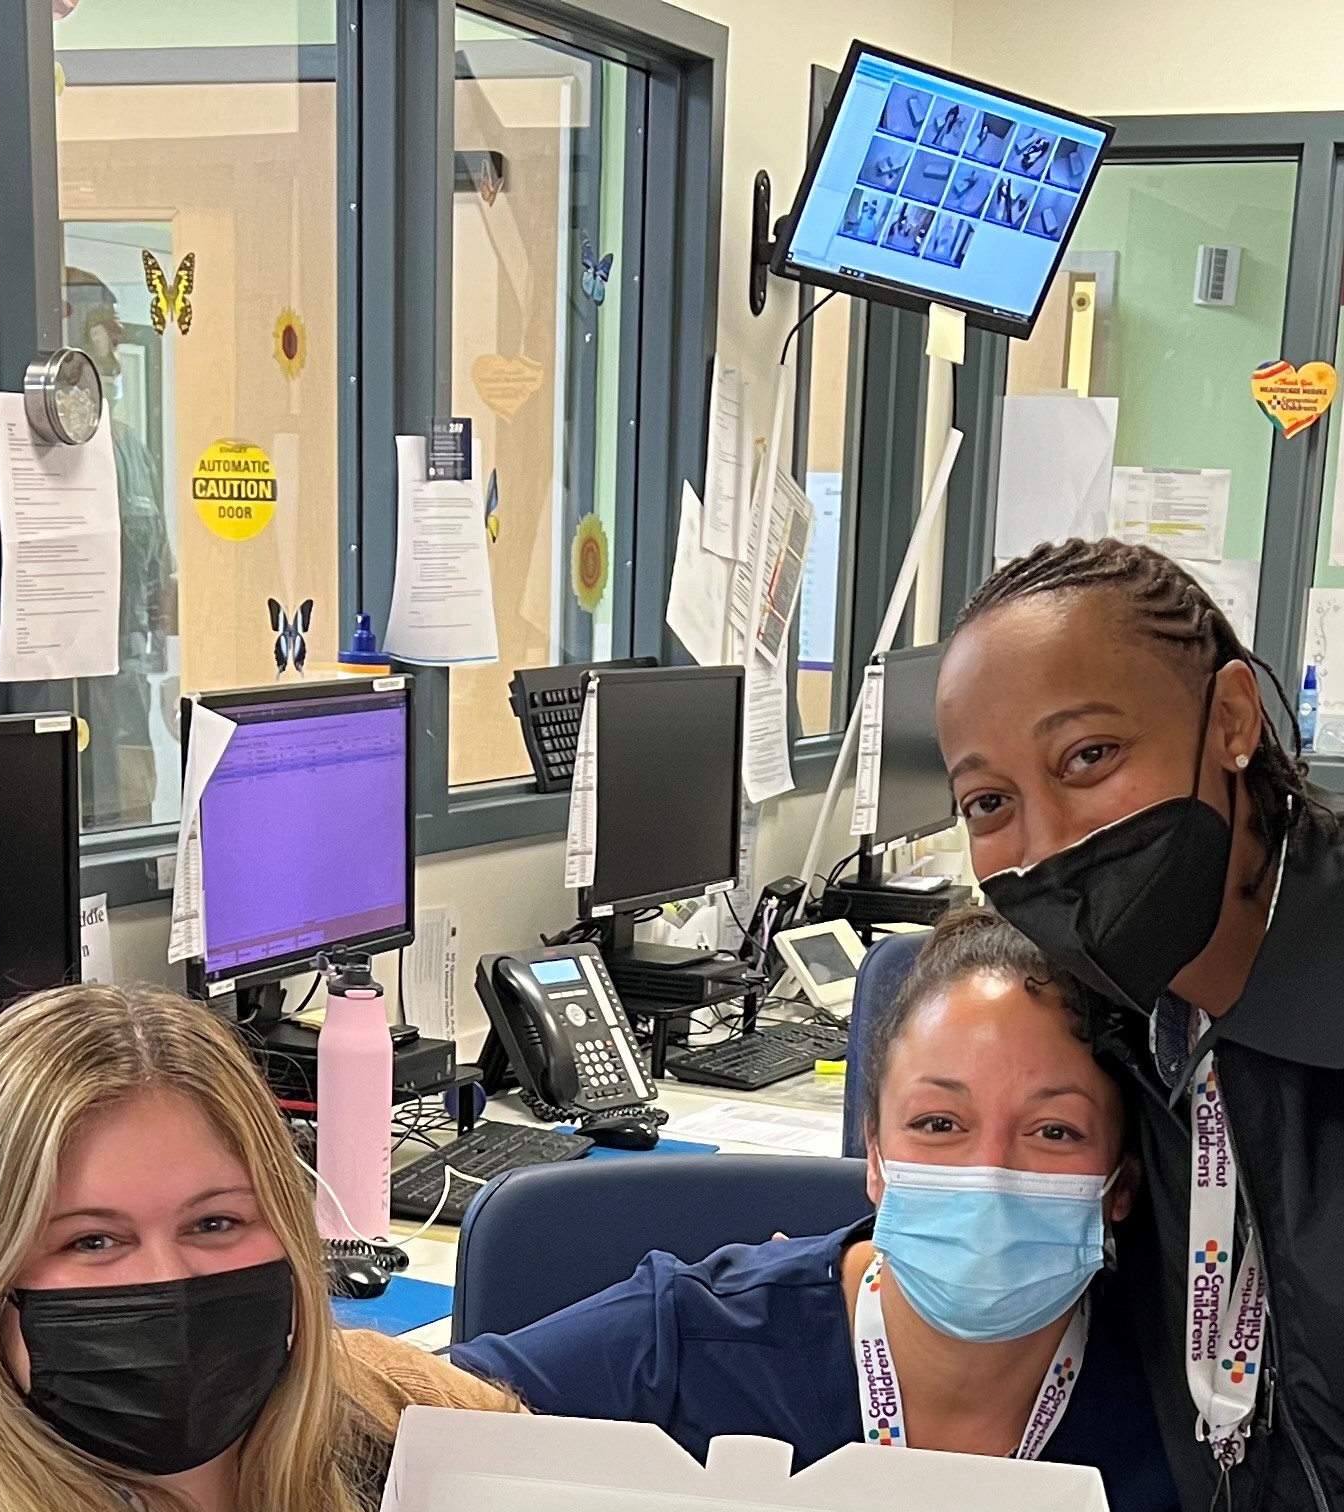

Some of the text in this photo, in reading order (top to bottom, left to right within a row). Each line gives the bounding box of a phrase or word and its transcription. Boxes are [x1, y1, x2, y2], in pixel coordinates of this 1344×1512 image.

[195, 479, 272, 499] CAUTION
[199, 460, 270, 473] AUTOMATIC
[218, 506, 252, 519] DOOR
[1197, 1103, 1216, 1188] Children's
[1191, 1274, 1210, 1362] Children's
[1207, 1273, 1225, 1361] Connecticut
[1229, 1266, 1256, 1351] Connecticut
[861, 1339, 881, 1418] Connecticut
[874, 1338, 898, 1418] Children's
